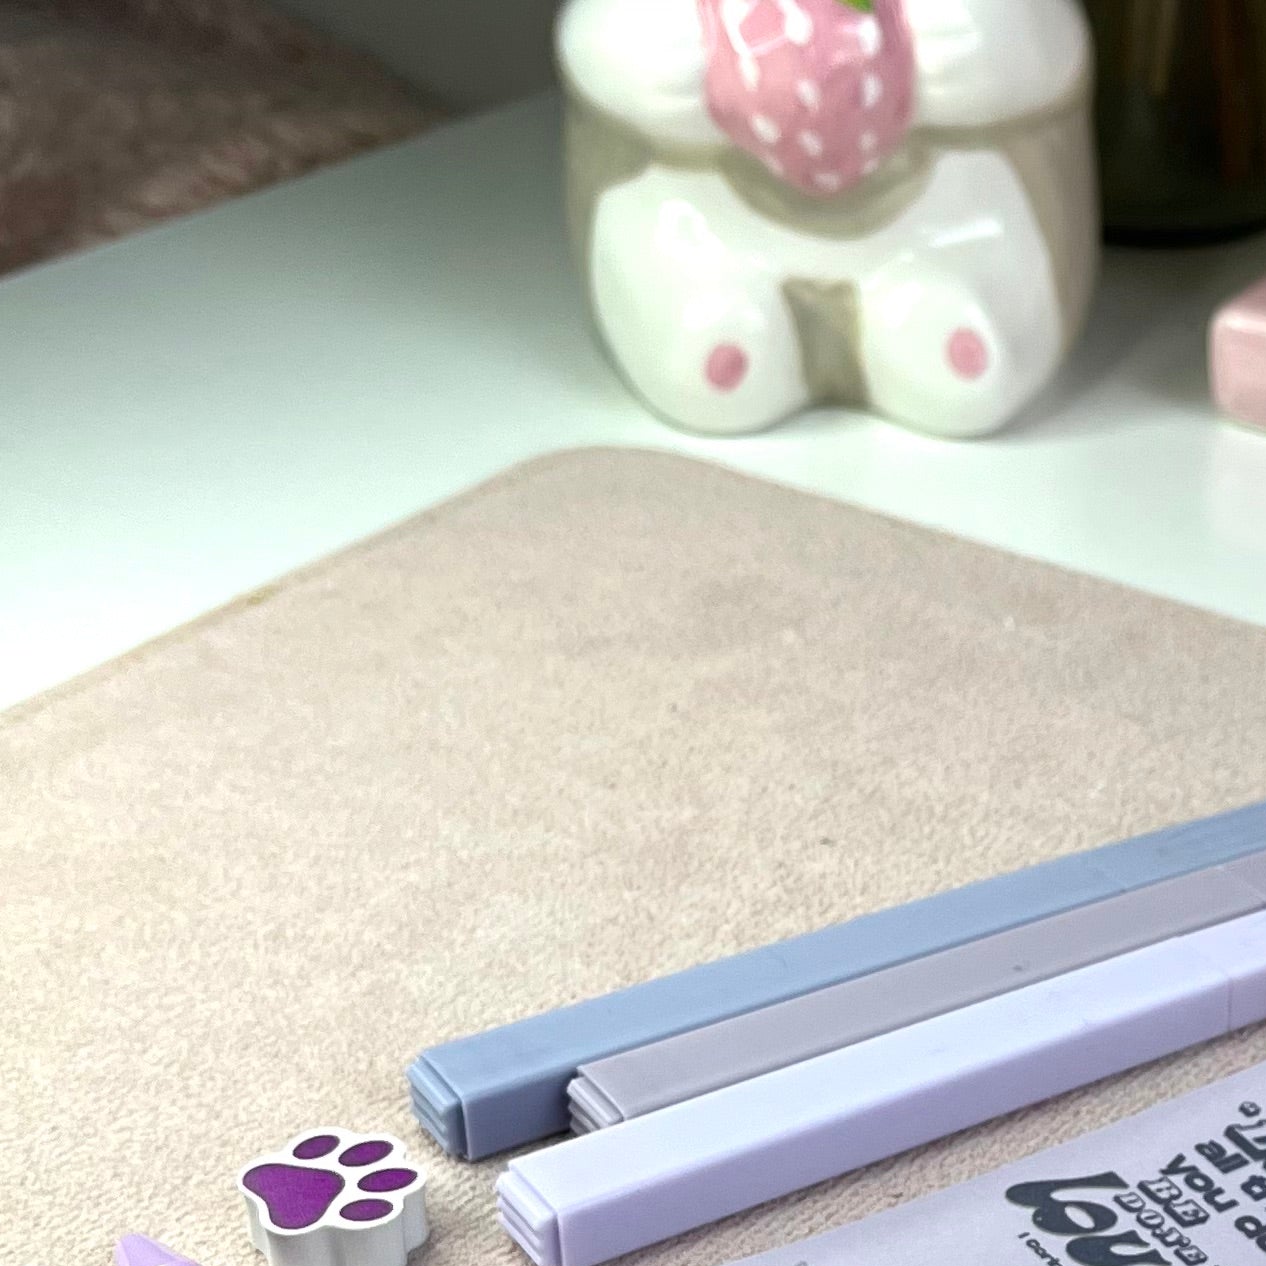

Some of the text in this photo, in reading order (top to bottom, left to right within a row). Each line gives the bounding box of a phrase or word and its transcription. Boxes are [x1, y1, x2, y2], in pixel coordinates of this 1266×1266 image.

[1159, 1153, 1239, 1213] you
[1194, 1139, 1250, 1174] all
[1113, 1192, 1208, 1266] DONE
[1137, 1176, 1210, 1228] BE
